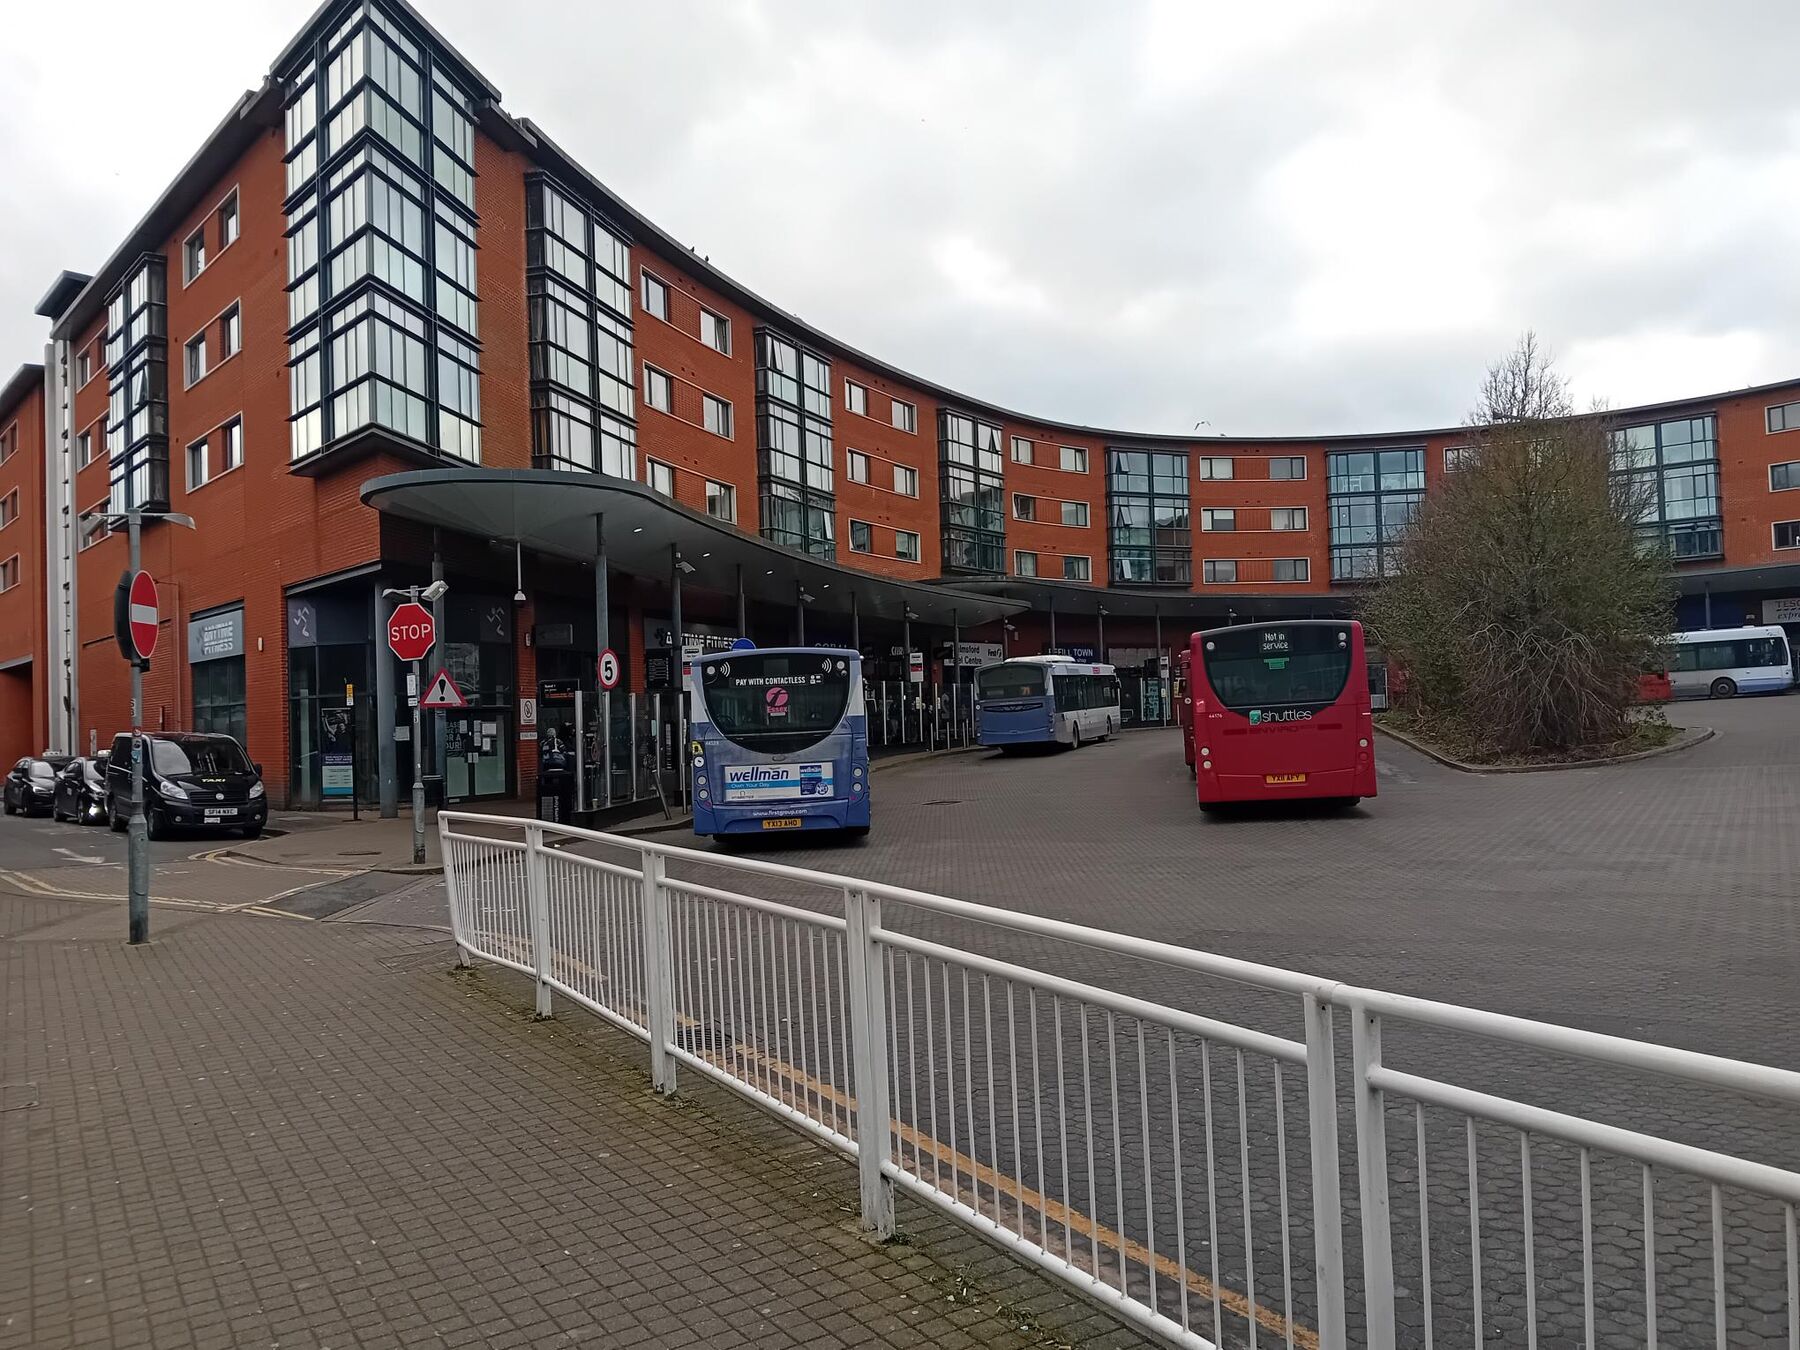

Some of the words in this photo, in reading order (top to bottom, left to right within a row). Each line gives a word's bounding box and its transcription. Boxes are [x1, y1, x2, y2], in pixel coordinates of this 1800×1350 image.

[391, 623, 431, 642] STOP
[1264, 632, 1278, 641] Not
[1278, 632, 1285, 641] in
[1263, 641, 1289, 650] service
[1073, 648, 1093, 657] TOWN
[604, 660, 613, 681] 5
[735, 678, 747, 686] PAY
[748, 678, 763, 686] WITH
[765, 676, 806, 685] CONTACTLESS
[1262, 709, 1312, 722] shuttles
[729, 766, 789, 782] wellman
[752, 809, 808, 817] www.firstgroup.com
